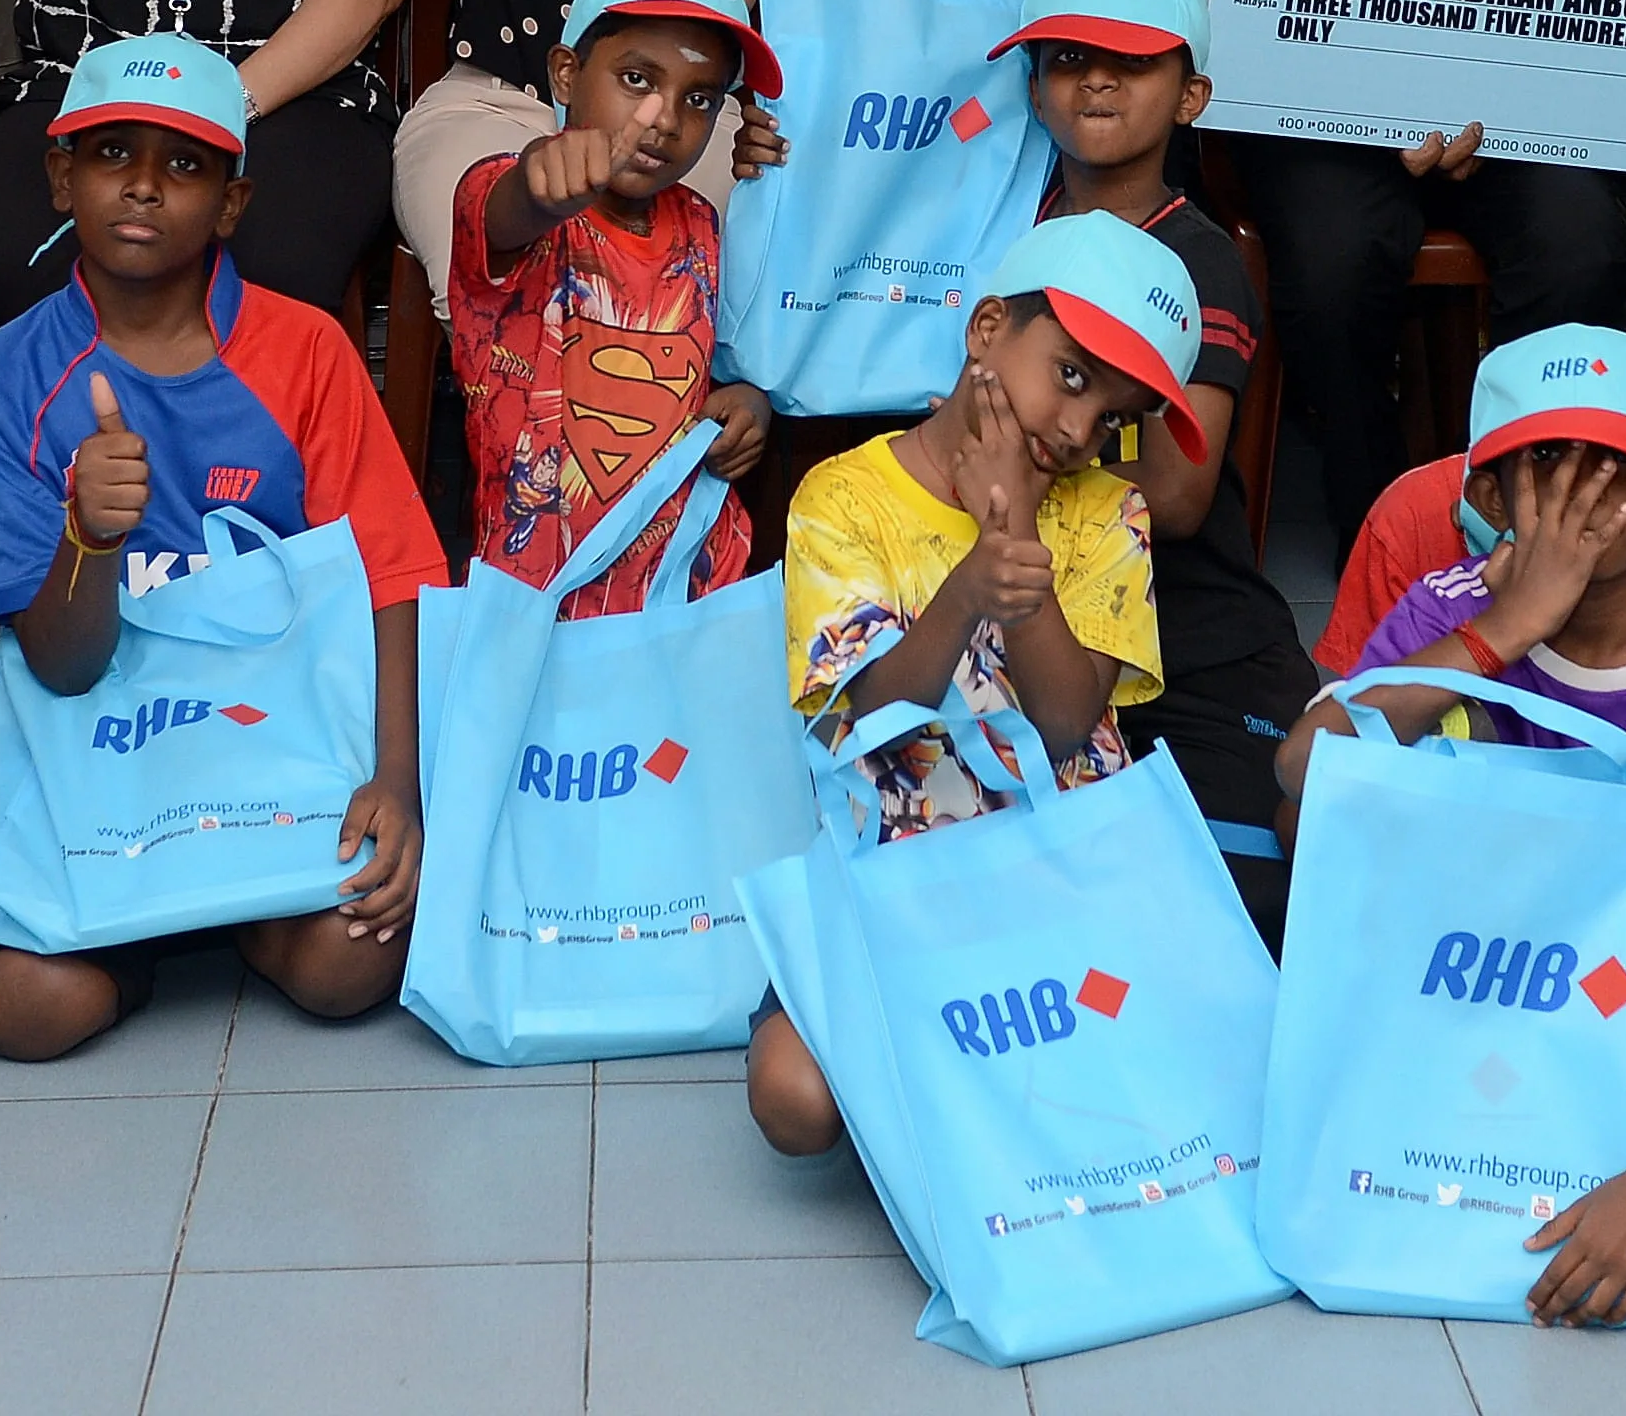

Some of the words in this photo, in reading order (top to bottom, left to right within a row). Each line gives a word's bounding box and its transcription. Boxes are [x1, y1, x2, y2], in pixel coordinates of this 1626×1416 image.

[1277, 20, 1333, 44] ONLY
[1484, 2, 1531, 37] FIVE
[124, 60, 166, 80] RHB
[843, 92, 953, 152] RHB
[1147, 286, 1182, 322] RHB
[1542, 358, 1588, 382] RHB
[91, 697, 212, 755] RHB
[518, 744, 639, 802] RHB
[97, 799, 279, 842] www.rhbgroup.com
[1420, 931, 1579, 1012] RHB
[941, 978, 1077, 1058] RHB
[1025, 1132, 1212, 1193] www.rhbgroup.com
[1374, 1184, 1394, 1197] RHB
[1398, 1186, 1429, 1204] Group
[1459, 1197, 1525, 1218] @RHBGroup
